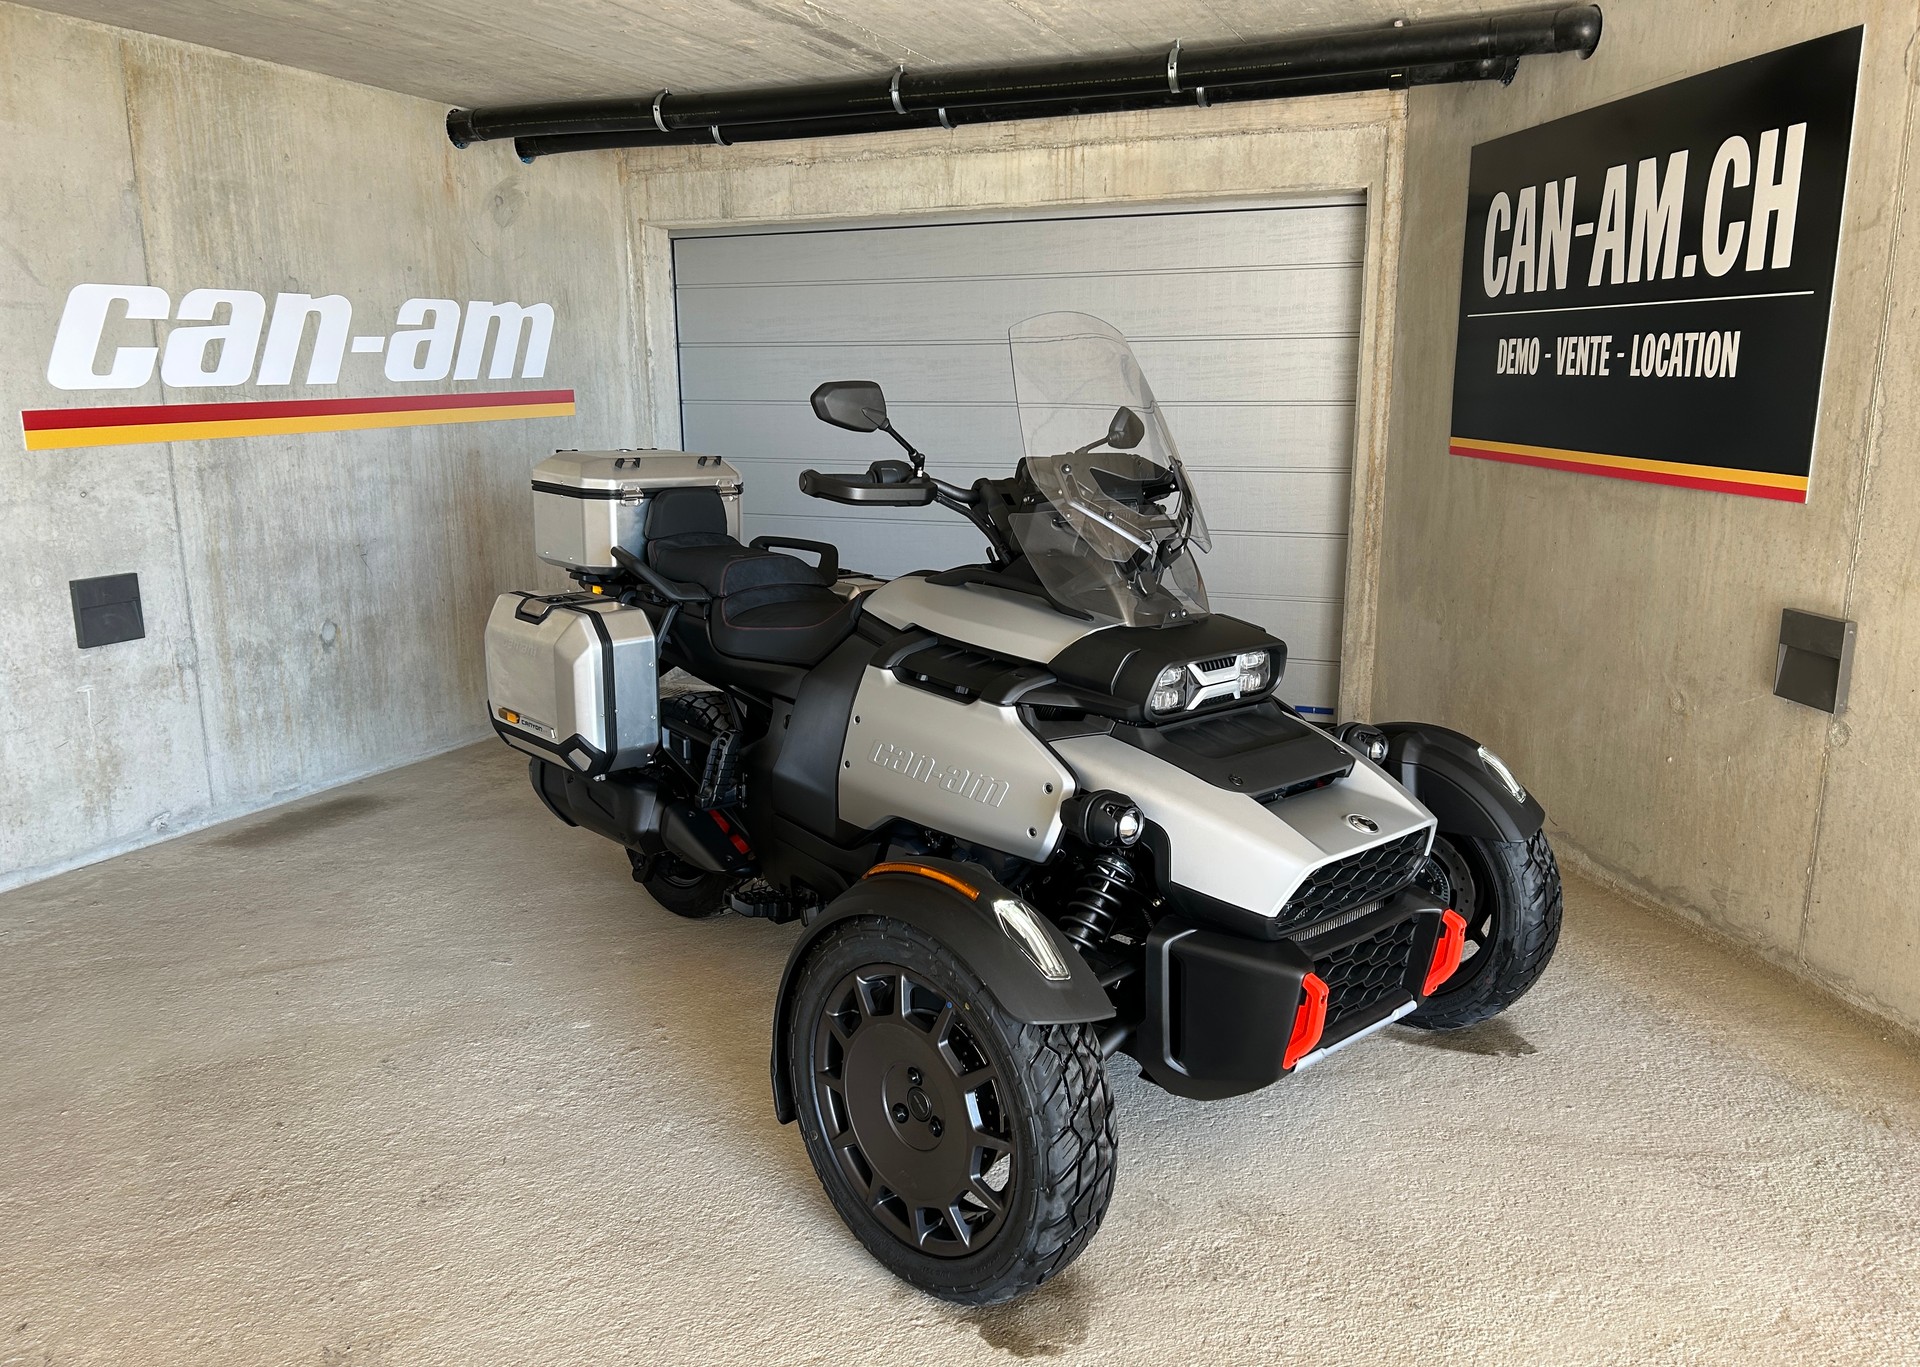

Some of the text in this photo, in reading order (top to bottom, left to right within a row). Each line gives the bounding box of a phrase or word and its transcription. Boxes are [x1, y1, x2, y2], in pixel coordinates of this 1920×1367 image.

[1482, 122, 1807, 298] CAN-AM.CH
[1497, 336, 1540, 375] DEMO
[1556, 335, 1613, 376] VENTE
[1629, 330, 1741, 378] LOCATION
